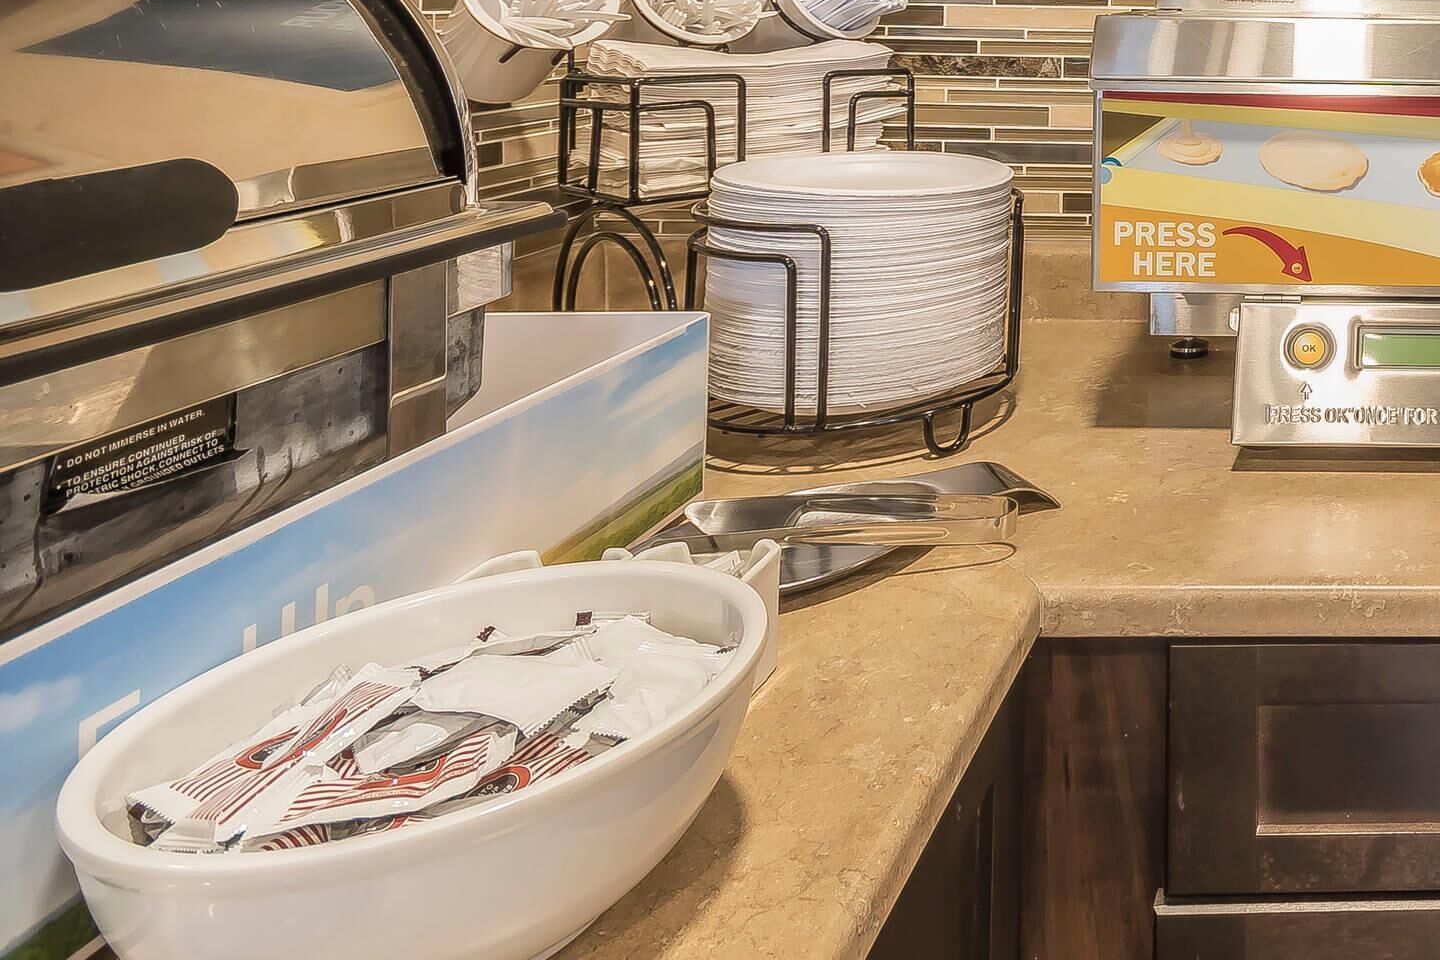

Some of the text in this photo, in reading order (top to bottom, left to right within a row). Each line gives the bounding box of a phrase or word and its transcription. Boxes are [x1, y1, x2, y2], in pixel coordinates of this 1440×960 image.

[1113, 221, 1216, 247] PRESS
[1133, 251, 1217, 277] HERE
[1301, 344, 1317, 353] OK
[1265, 404, 1322, 425] PRESS
[1325, 406, 1348, 425] OK
[1404, 407, 1438, 426] FOR
[67, 455, 83, 468] DO
[84, 446, 107, 461] NOT
[108, 428, 156, 452] IMMERSE
[157, 422, 168, 434] IN
[159, 445, 206, 469] CONNECT
[206, 438, 219, 451] TO
[183, 444, 225, 470] OUTLETS
[66, 434, 186, 488] TO ENSURE CONTINUED
[66, 463, 135, 497] PROTECTION
[135, 444, 180, 470] AGAINST
[180, 436, 203, 454] RISK
[204, 429, 218, 443] OF
